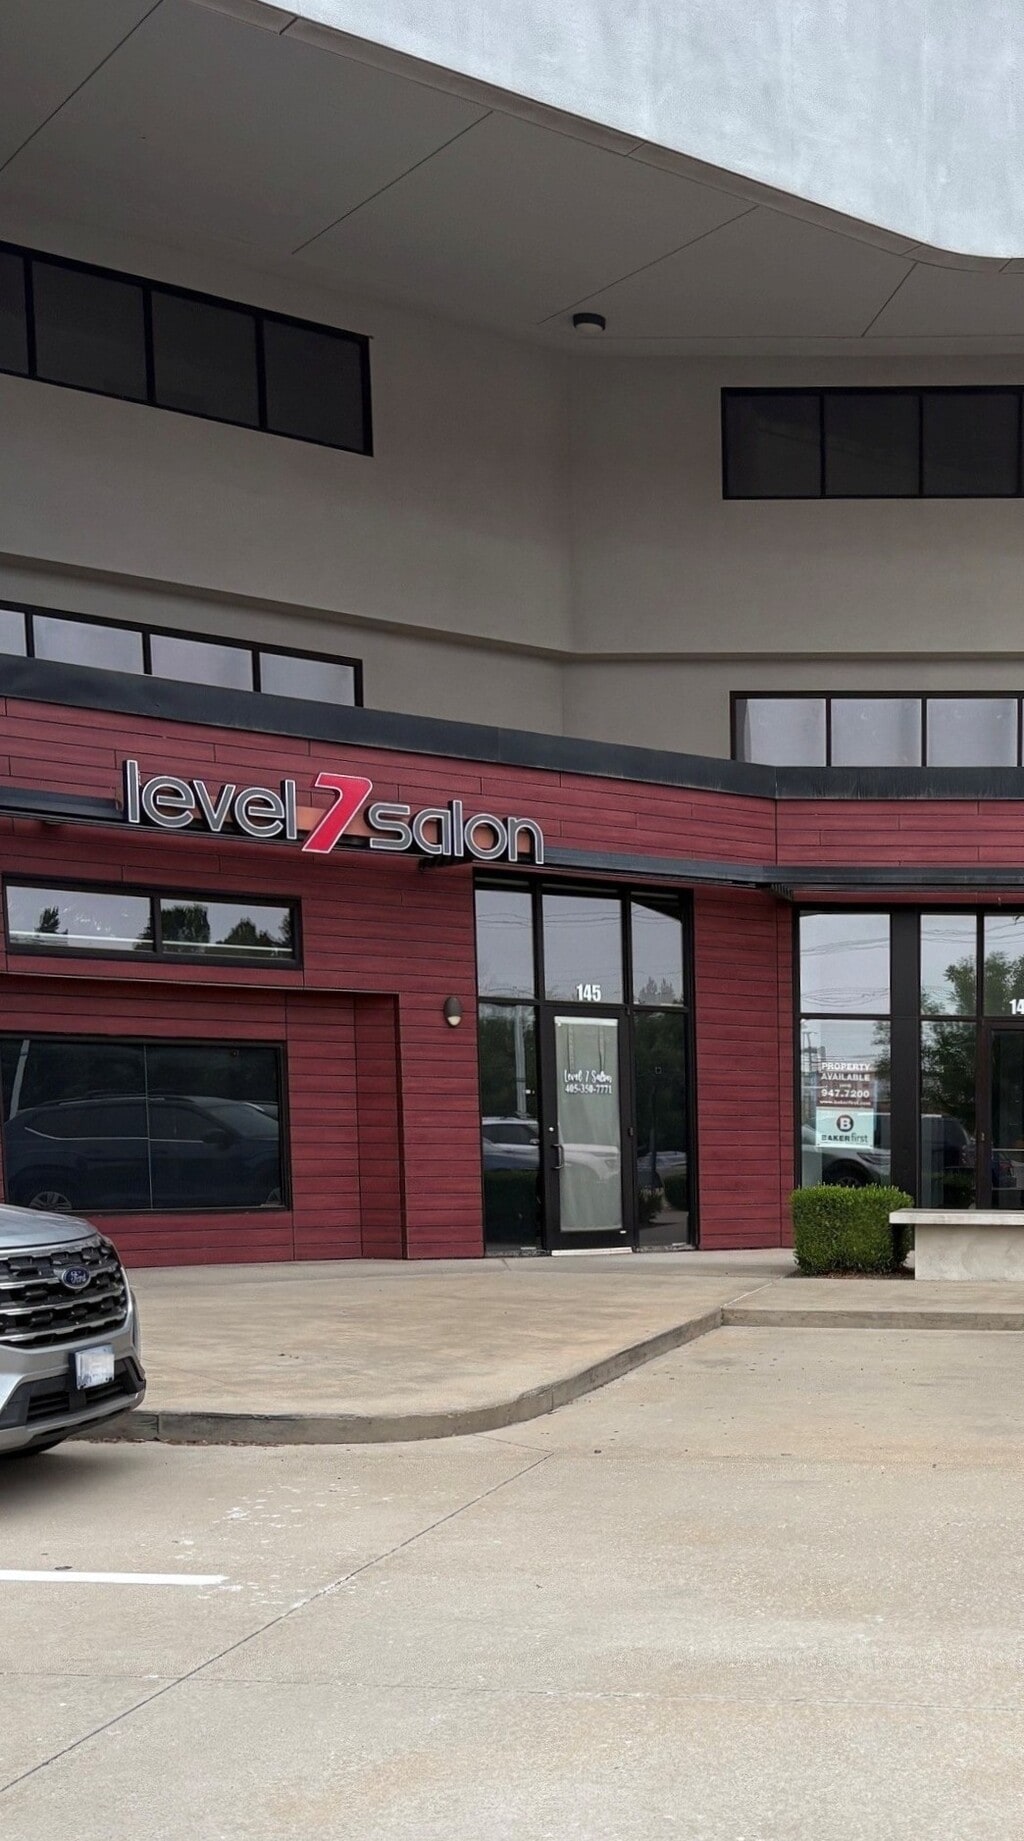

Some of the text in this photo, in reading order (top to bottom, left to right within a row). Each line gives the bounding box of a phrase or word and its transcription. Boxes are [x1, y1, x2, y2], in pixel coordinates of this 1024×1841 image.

[122, 759, 545, 865] level 7 salon
[576, 983, 602, 1001] 145
[821, 1062, 871, 1071] PROPERTY
[821, 1073, 870, 1081] AVAILABLE
[821, 1089, 870, 1098] 947.7200
